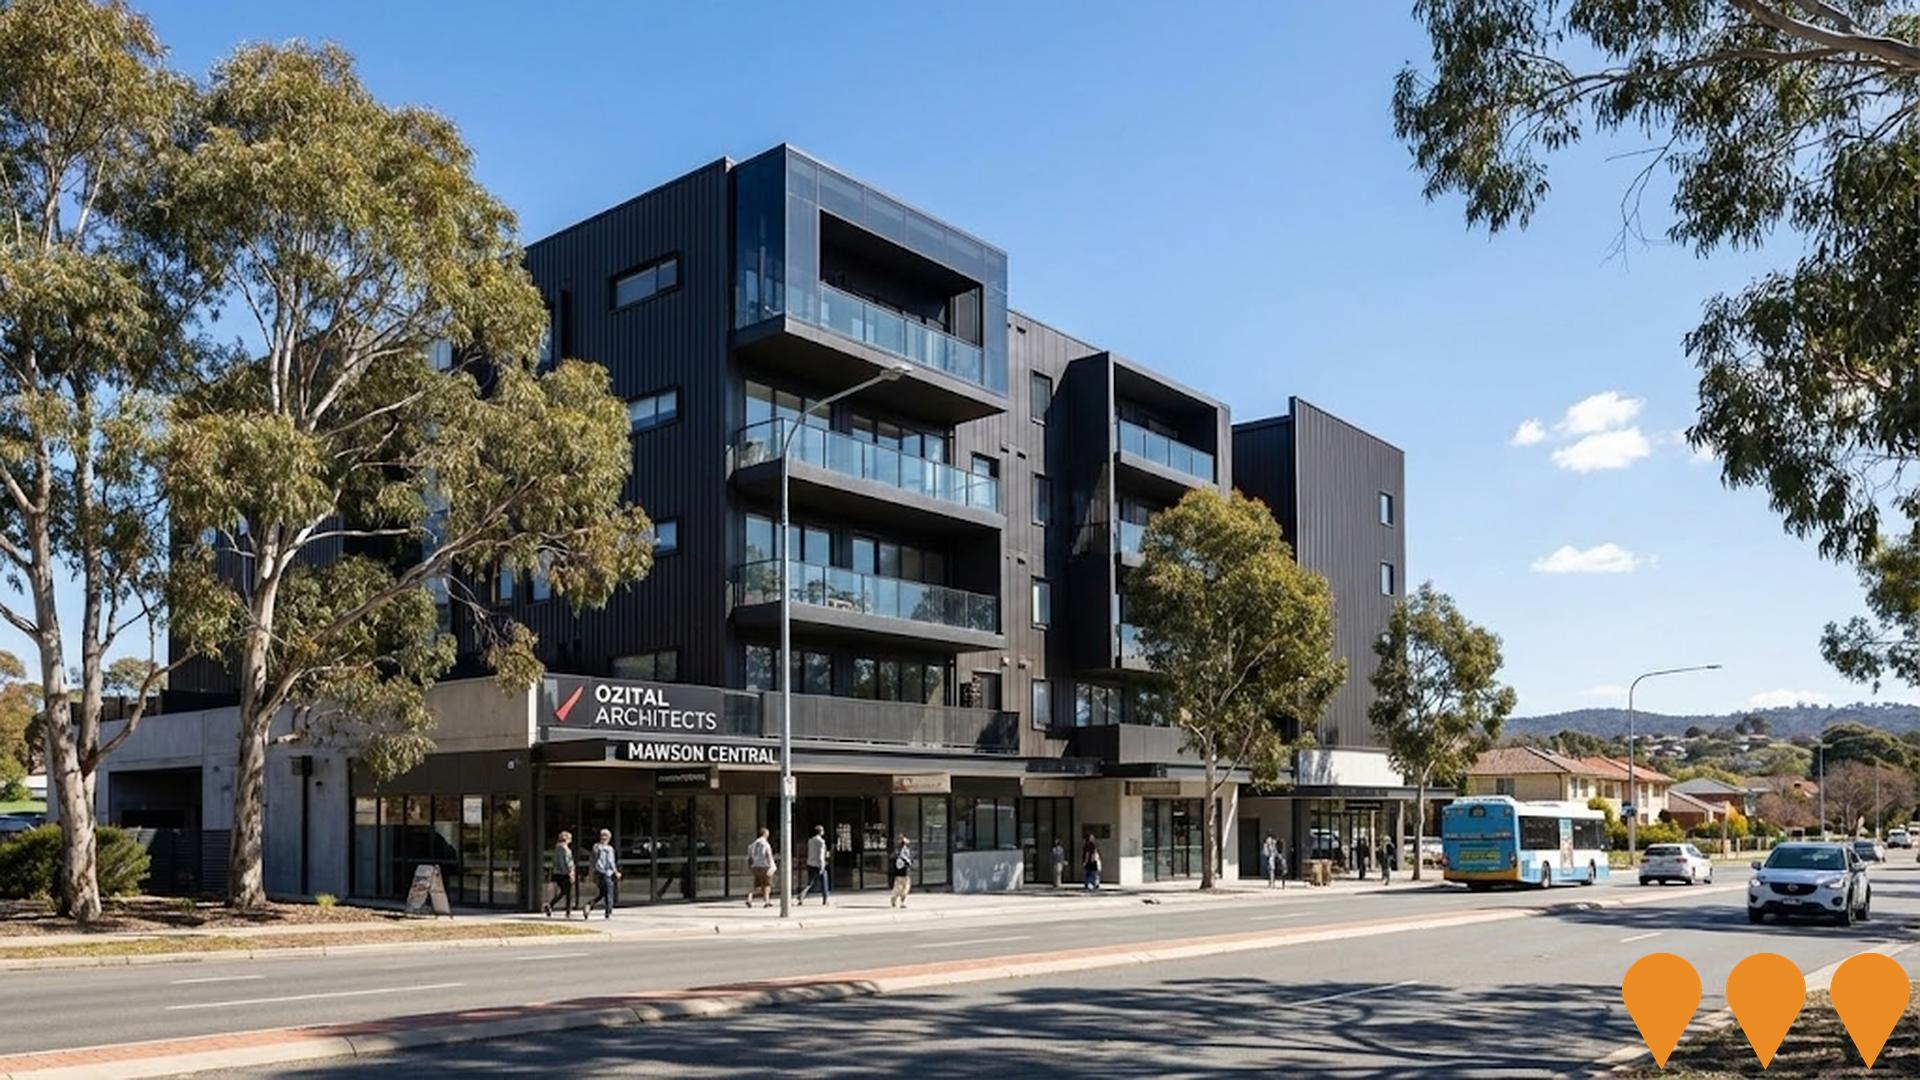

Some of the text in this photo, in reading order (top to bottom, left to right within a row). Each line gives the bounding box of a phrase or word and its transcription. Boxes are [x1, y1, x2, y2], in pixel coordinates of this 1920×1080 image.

[595, 684, 670, 706] OZITAL
[595, 706, 717, 730] ARCHITECTS
[628, 742, 778, 764] MAWSON CENTRAL
